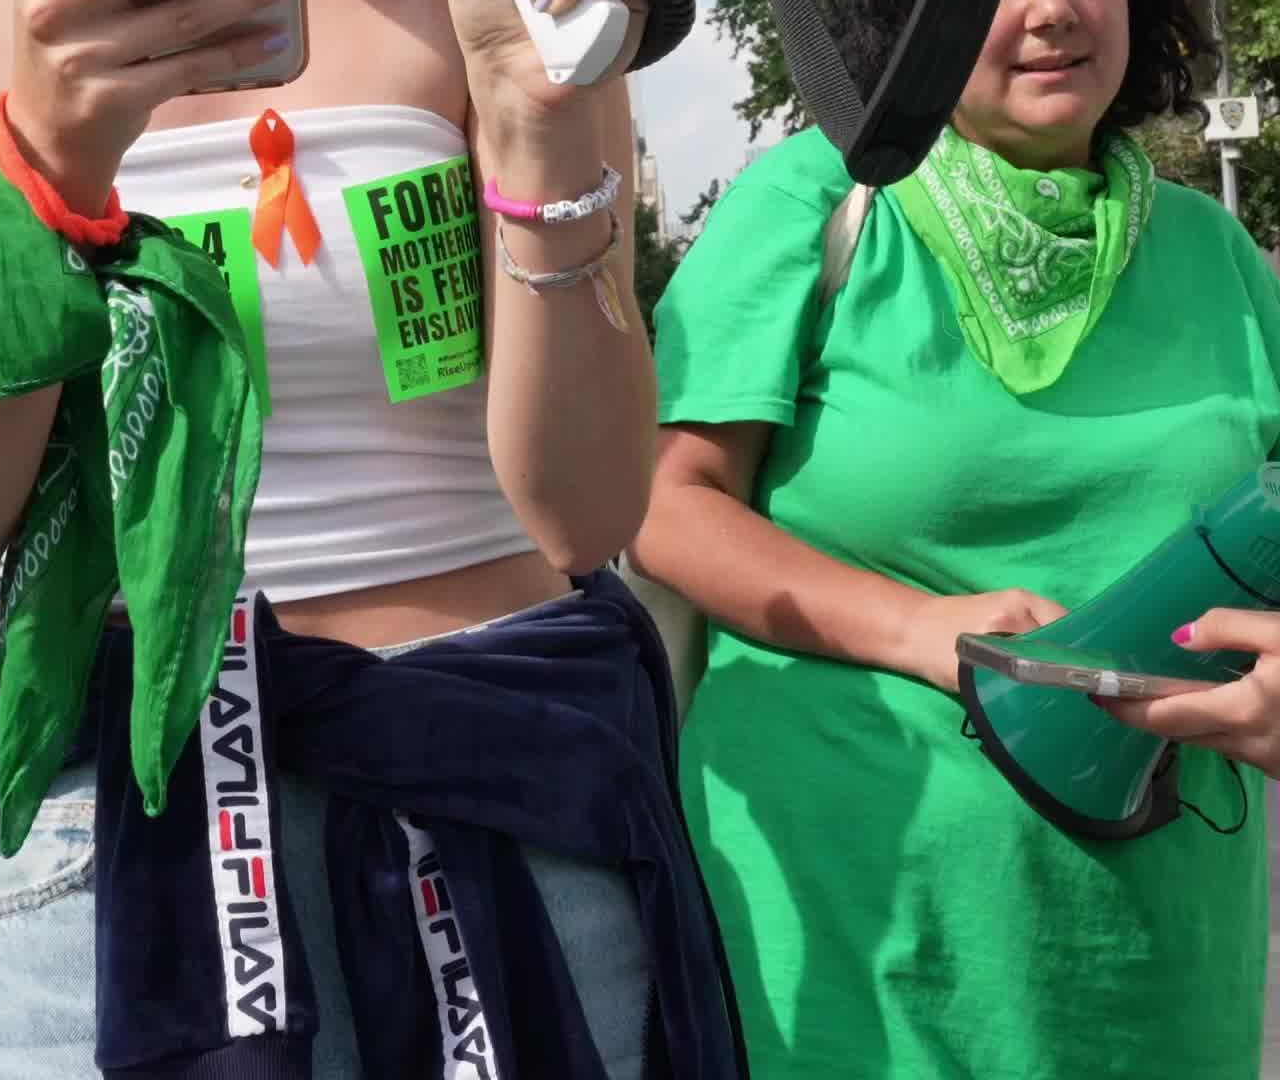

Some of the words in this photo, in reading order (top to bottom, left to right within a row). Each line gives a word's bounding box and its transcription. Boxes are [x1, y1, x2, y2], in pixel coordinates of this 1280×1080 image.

[366, 161, 478, 240] FORCE
[379, 220, 480, 277] MOTHERH
[390, 275, 425, 317] IS
[431, 254, 481, 306] FEM
[398, 299, 480, 349] ENSLAV
[211, 723, 263, 851] FILA
[221, 856, 275, 986] FILA
